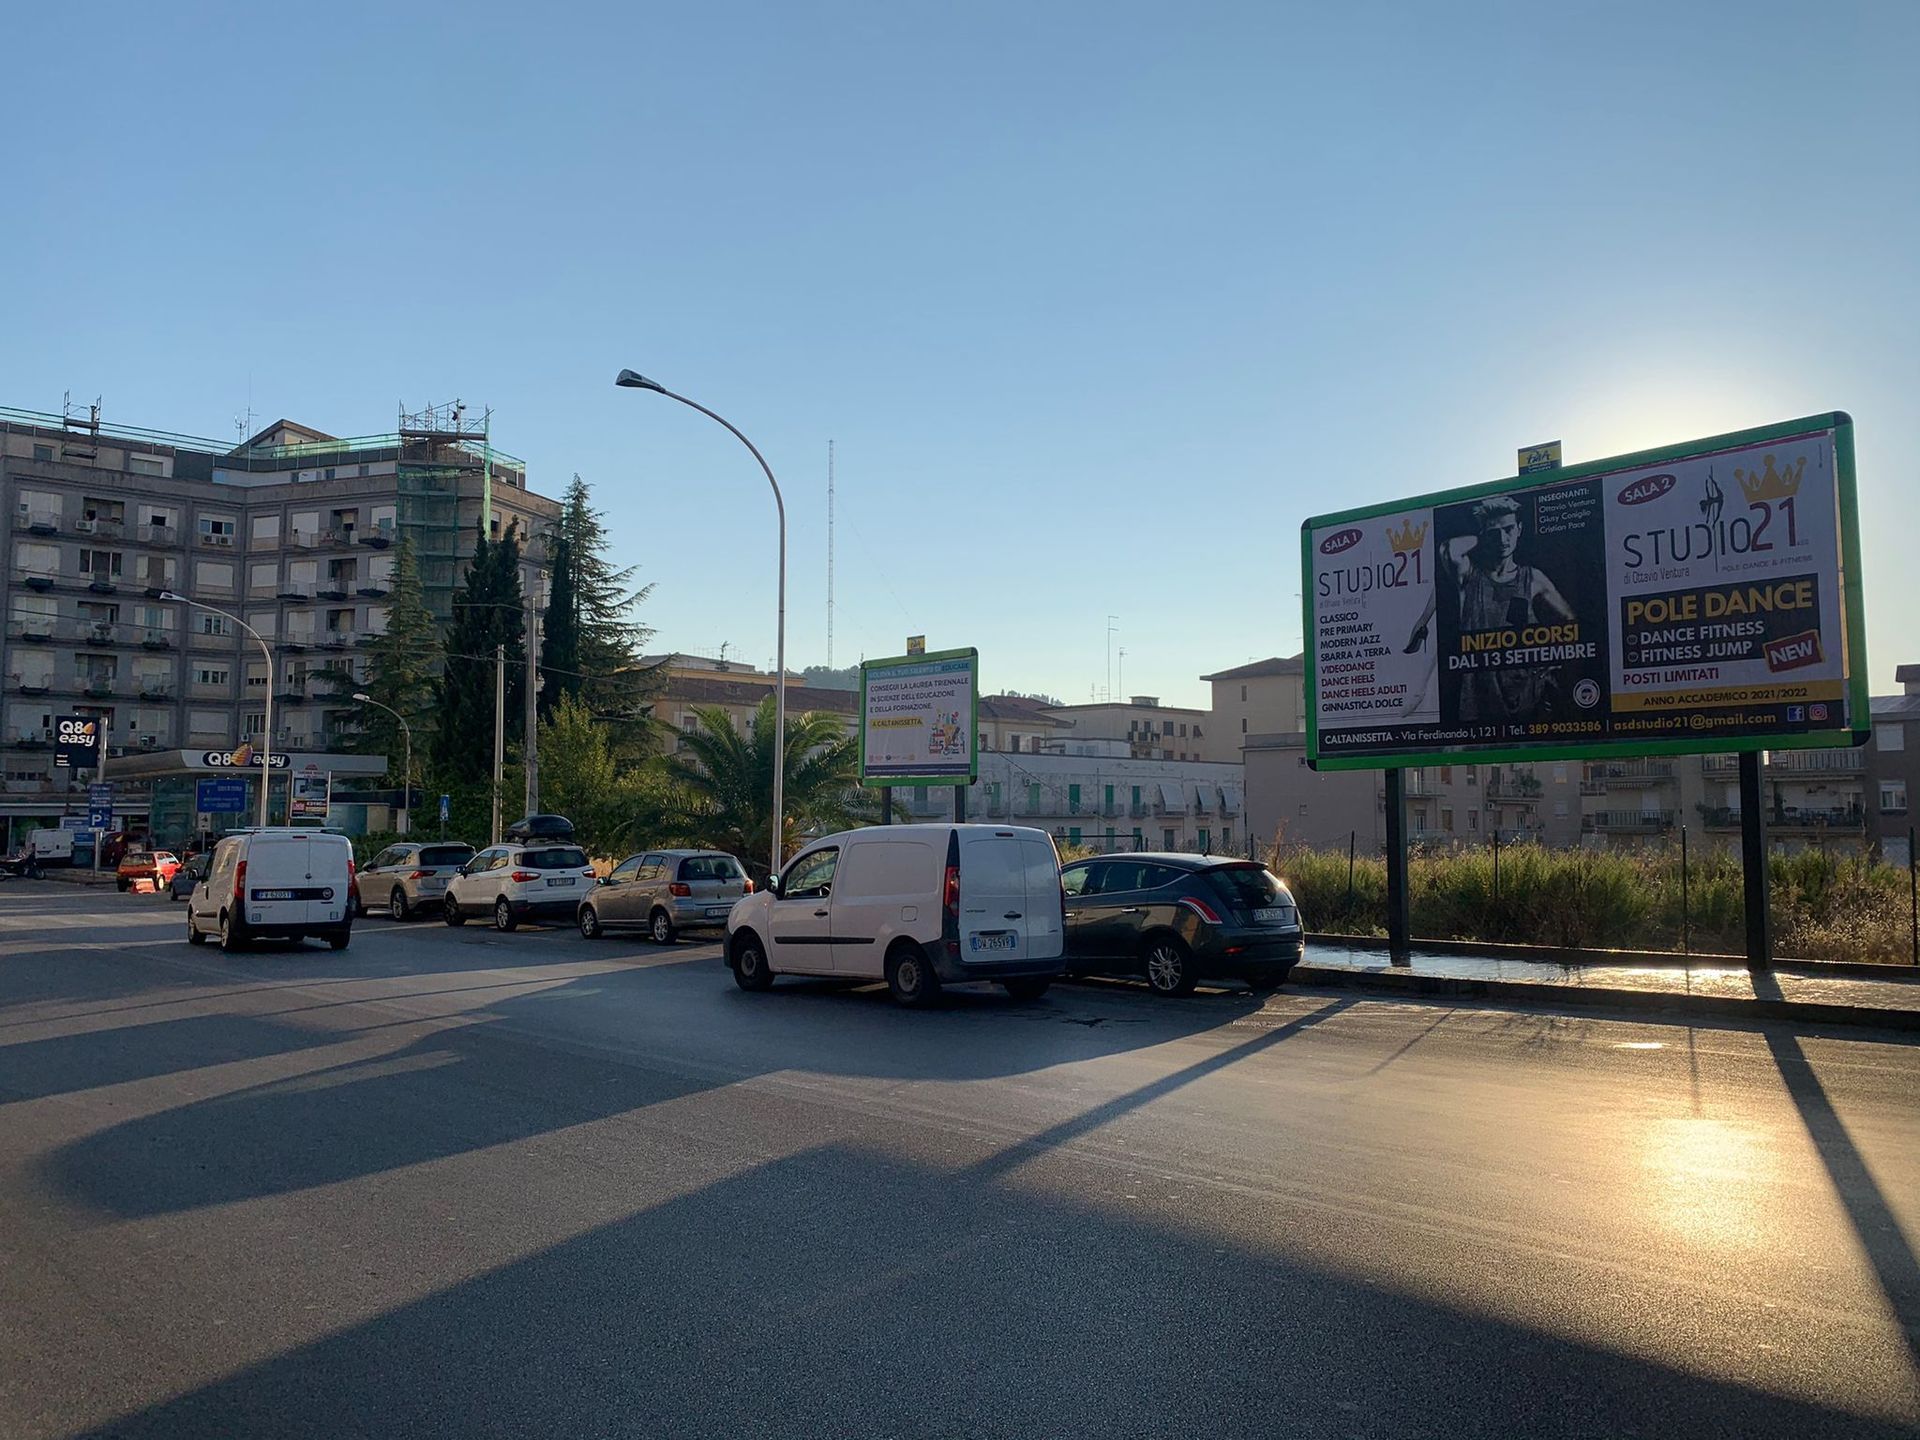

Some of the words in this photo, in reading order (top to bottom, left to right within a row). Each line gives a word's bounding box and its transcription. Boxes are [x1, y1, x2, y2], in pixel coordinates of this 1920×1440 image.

[1625, 483, 1660, 502] SALA
[1662, 477, 1672, 490] 2
[1623, 496, 1797, 568] STUDIO21
[1325, 536, 1350, 552] SALA
[1351, 532, 1358, 542] 1
[1319, 549, 1421, 597] STUDIO21
[1624, 574, 1632, 585] di
[1660, 566, 1691, 580] Ventura
[1627, 595, 1698, 625] POLE
[1705, 581, 1813, 618] DANCE
[1320, 612, 1359, 624] CLASSICO
[1320, 627, 1334, 637] PRE
[1336, 623, 1374, 635] PRIMARY
[1461, 630, 1517, 652] INIZIO
[1521, 623, 1579, 646] CORSI
[1640, 627, 1695, 645] DANCE
[1700, 620, 1765, 640] FITNESS
[1320, 637, 1357, 649] MODERN
[1359, 634, 1381, 645] JAZZ
[1321, 651, 1353, 662] SBARRA
[1355, 650, 1362, 658] A
[1364, 646, 1391, 658] TERRA
[1449, 654, 1478, 670] DAL
[1483, 652, 1501, 667] 13
[1505, 643, 1596, 665] SETTEMBRE
[1641, 645, 1701, 663] FITNESS
[1706, 640, 1753, 658] JUMP
[1770, 639, 1813, 665] NEW
[1321, 661, 1375, 674] VIDEODANCE
[1321, 676, 1350, 687] DANCE
[1351, 674, 1375, 685] HEELS
[1623, 671, 1660, 685] POSTI
[1664, 667, 1719, 683] LIMITATI
[870, 684, 899, 693] CONSEGUI
[909, 680, 933, 689] LAUREA
[934, 677, 969, 686] TRIENNALE
[1322, 689, 1350, 699] DANCE
[1351, 687, 1376, 697] HEELS
[1377, 684, 1407, 695] ADULTI
[877, 694, 900, 702] SCIENZE
[1322, 700, 1373, 712] GINNASTICA
[1375, 698, 1403, 708] DOLCE
[1643, 695, 1675, 707] ANNO
[1677, 691, 1748, 704] ACCADEMICO
[1750, 687, 1808, 700] 2021/2022
[875, 705, 891, 713] DELLA
[60, 720, 83, 734] Q8
[1324, 732, 1393, 745] CALTANISSETTA
[1400, 731, 1417, 741] Via
[1418, 729, 1469, 740] Ferdinando
[1479, 726, 1497, 737] 121
[1509, 725, 1526, 736] Tel.
[1528, 723, 1549, 735] 389
[1551, 721, 1602, 734] 9033586
[1614, 713, 1776, 731] asdstudio21@gmail.com
[59, 734, 95, 747] easy
[208, 753, 231, 765] Q8
[92, 814, 102, 826] P
